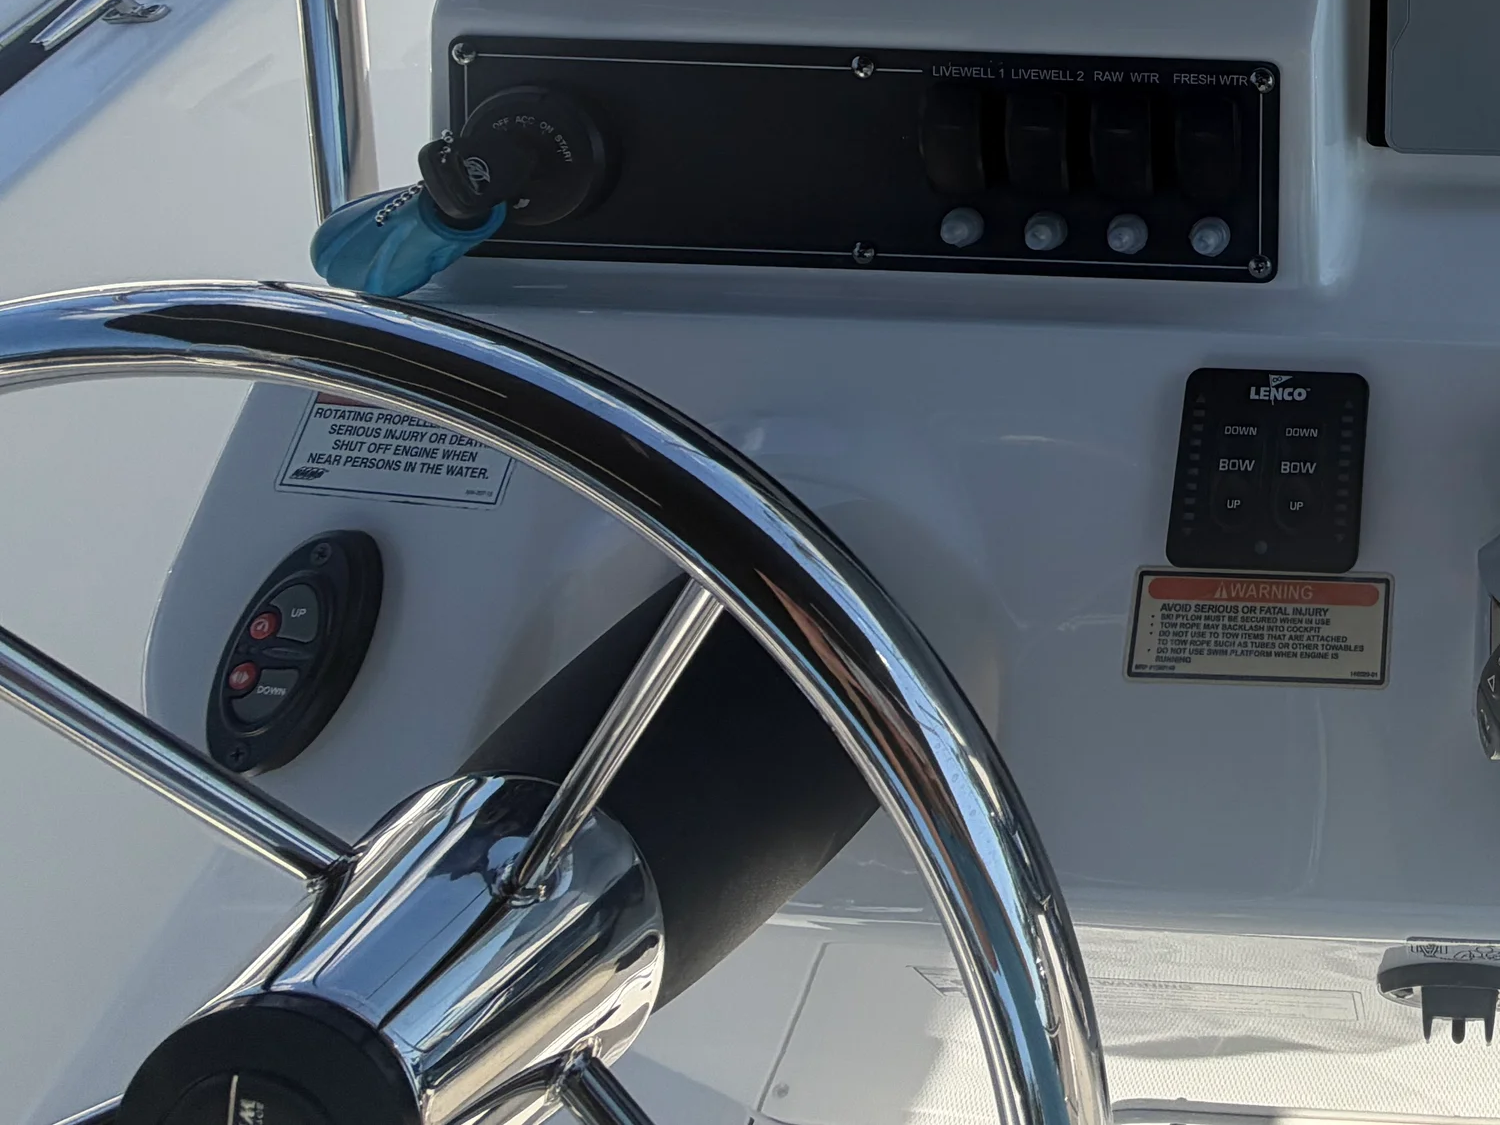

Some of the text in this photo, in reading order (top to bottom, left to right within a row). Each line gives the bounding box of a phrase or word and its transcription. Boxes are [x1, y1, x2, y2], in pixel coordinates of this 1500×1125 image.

[932, 65, 1004, 79] LIVEWELL 1
[1011, 68, 1085, 82] LIVEWELL 2
[1093, 71, 1160, 84] RAW WTR
[1173, 73, 1248, 86] FRESH WTR
[492, 117, 509, 129] OFF
[515, 115, 535, 124] ACC
[540, 121, 554, 134] ON
[554, 134, 573, 162] START
[1250, 386, 1307, 401] LENCO
[314, 407, 373, 423] ROTATING
[328, 424, 488, 448] SERIOUS INJURY OR DEA
[1224, 425, 1257, 435] DOWN
[1285, 427, 1318, 437] DOWN
[332, 439, 478, 463] SHUT OFF ENGINE WHEN
[307, 452, 489, 479] NEAR PERSONS IN THE WATER.
[1218, 458, 1256, 472] BOW
[1280, 461, 1317, 474] BOW
[1226, 499, 1241, 509] UP
[1289, 501, 1304, 511] UP
[1230, 583, 1313, 600] WARNING
[291, 608, 307, 618] UP
[1160, 603, 1329, 617] AVOID SERIOUS OR FATAL INJURY
[1231, 615, 1238, 623] BE
[1240, 616, 1278, 624] SECURED
[1279, 617, 1304, 625] WHEN
[1314, 618, 1331, 626] USE
[1180, 622, 1201, 630] ROPE
[1221, 624, 1265, 632] BACKLASH
[1266, 625, 1285, 633] INTO
[1286, 626, 1322, 634] COCKPIT
[1159, 630, 1170, 638] DO
[1306, 635, 1348, 643] ATTACHED
[1251, 641, 1276, 649] TUBES
[1278, 642, 1290, 650] OR
[1291, 643, 1319, 651] OTHER
[1321, 644, 1364, 652] TOWABLES
[1229, 650, 1272, 658] PLATFORM
[1274, 651, 1298, 659] WHEN
[256, 685, 287, 696] DOWN
